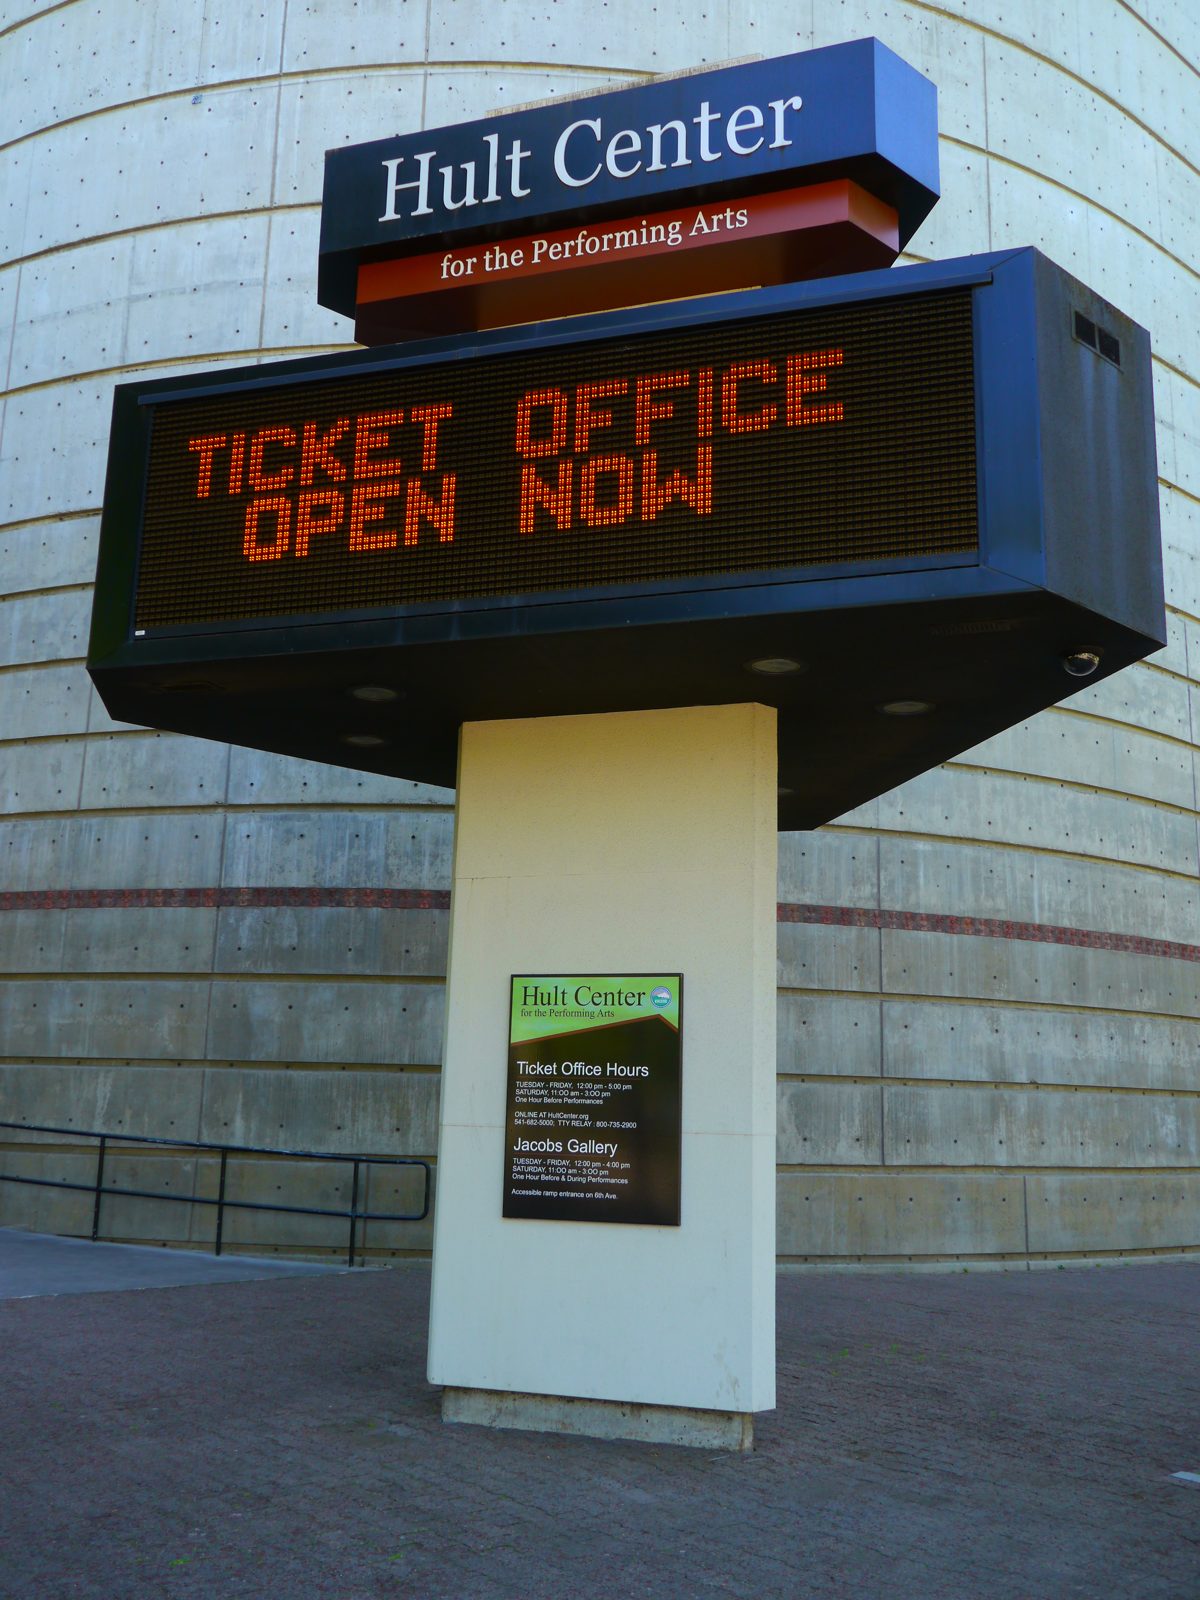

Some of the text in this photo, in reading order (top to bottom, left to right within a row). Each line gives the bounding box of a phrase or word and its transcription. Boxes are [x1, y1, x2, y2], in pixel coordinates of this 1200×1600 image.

[378, 95, 802, 222] Hult Center
[440, 206, 748, 279] for the Performing Arts
[188, 348, 844, 498] TICKET OFFICE
[243, 445, 712, 562] OPEN NOW
[521, 986, 646, 1007] Hult Center
[521, 1009, 615, 1019] for the Performing Arts
[517, 1061, 649, 1077] Ticket Office Hours
[513, 1137, 618, 1157] Jacobs Gallery
[567, 1176, 586, 1184] During
[588, 1176, 628, 1184] Performances
[511, 1188, 541, 1196] Accessible
